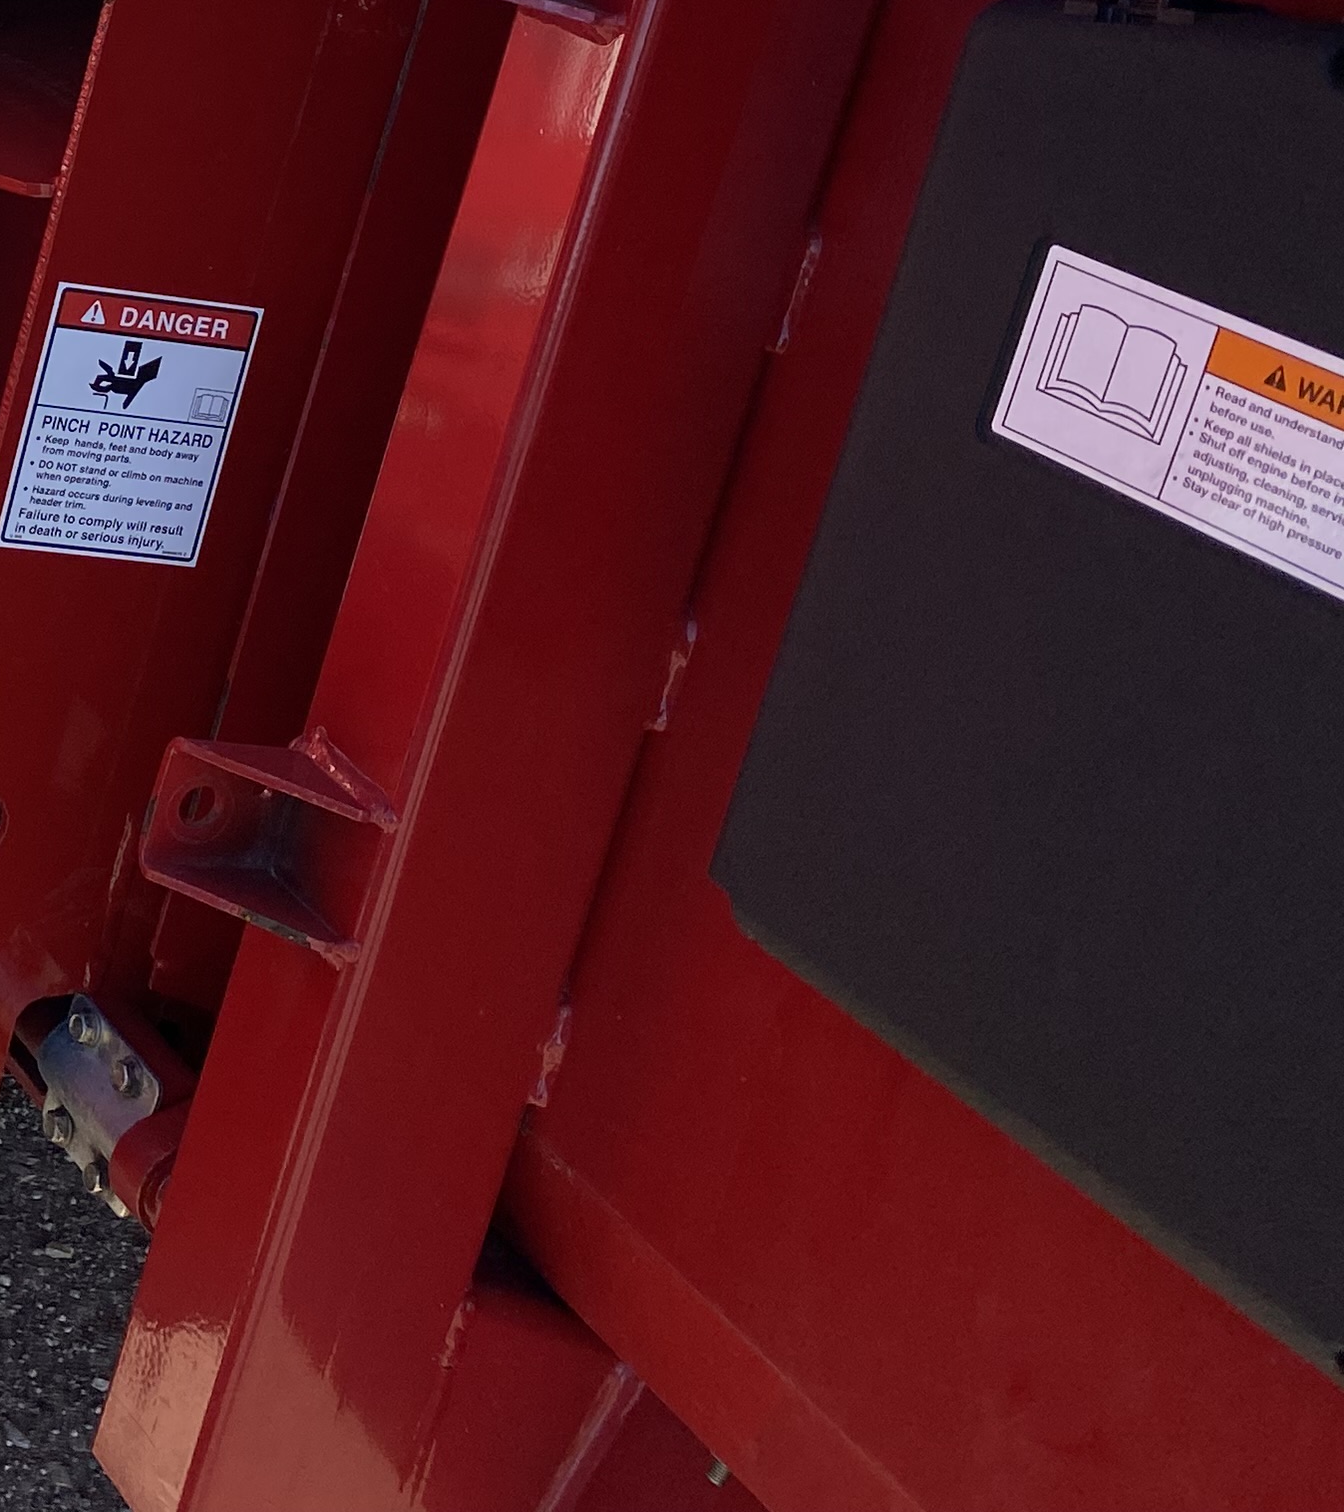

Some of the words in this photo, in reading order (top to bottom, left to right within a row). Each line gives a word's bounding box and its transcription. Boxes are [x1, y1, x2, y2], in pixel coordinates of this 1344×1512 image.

[119, 306, 230, 340] DANGER
[1215, 386, 1248, 408] Read
[1248, 402, 1273, 419] and
[1298, 376, 1344, 415] WA
[41, 414, 90, 434] PINCH
[98, 421, 146, 440] POINT
[148, 426, 214, 449] HAZARD
[1209, 402, 1248, 426] before
[1250, 422, 1275, 440] use.
[41, 445, 64, 456] from
[66, 449, 102, 462] moving
[104, 454, 132, 464] parts.
[44, 434, 70, 446] Keep
[74, 438, 106, 452] hands,
[108, 442, 128, 452] feet
[128, 446, 147, 455] and
[149, 447, 174, 460] body
[174, 452, 200, 462] away
[1204, 418, 1234, 441] Keep
[1236, 435, 1252, 448] all
[1254, 442, 1297, 468] shields
[1299, 460, 1312, 474] in
[36, 470, 62, 482] when
[64, 475, 112, 488] operating.
[38, 459, 54, 470] DO
[56, 462, 78, 472] NOT
[79, 464, 106, 476] stand
[108, 468, 120, 477] or
[120, 470, 148, 480] climb
[149, 474, 162, 483] on
[163, 475, 204, 488] machine
[1193, 448, 1250, 484] adjusting,
[1253, 477, 1308, 510] cleaning,
[1199, 432, 1226, 453] Shut
[1228, 446, 1246, 461] off
[1247, 456, 1288, 480] engine
[1290, 473, 1331, 499] before
[29, 496, 63, 508] header
[64, 500, 87, 510] trim.
[32, 485, 66, 497] Hazard
[68, 492, 100, 501] occurs
[102, 495, 134, 506] during
[136, 497, 172, 511] leveling
[174, 502, 193, 512] and
[1187, 466, 1253, 504] unplugging
[1255, 496, 1310, 530] machine.
[18, 507, 60, 522] Failure
[63, 513, 76, 524] to
[78, 516, 124, 532] comply
[126, 521, 147, 532] will
[149, 524, 184, 536] result
[1182, 476, 1209, 498] Stay
[1210, 492, 1242, 511] clear
[1242, 507, 1258, 520] of
[1258, 512, 1285, 534] high
[1286, 528, 1343, 560] pressure
[14, 522, 26, 534] in
[28, 524, 62, 538] death
[64, 530, 78, 539] or
[80, 532, 124, 546] serious
[127, 534, 164, 550] injury.
